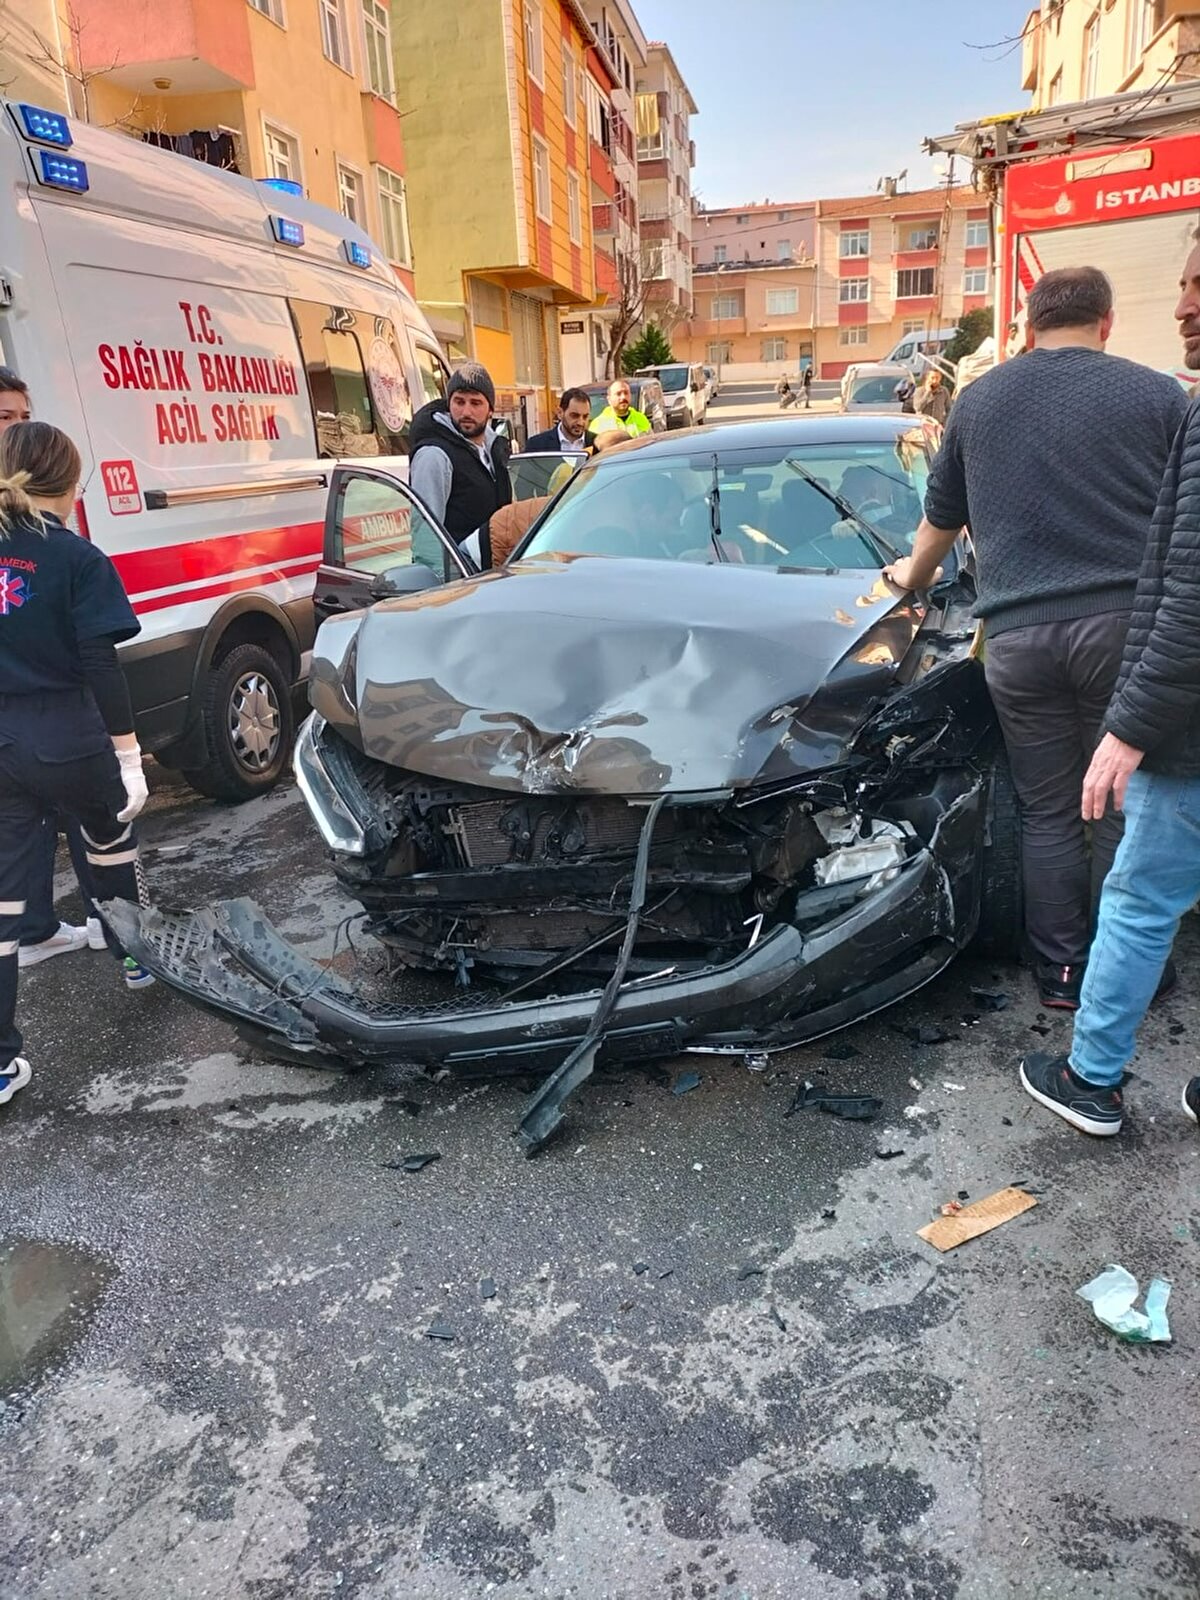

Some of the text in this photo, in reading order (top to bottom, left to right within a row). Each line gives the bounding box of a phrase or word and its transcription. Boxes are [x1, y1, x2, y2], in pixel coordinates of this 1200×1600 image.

[179, 302, 223, 345] T.C.
[98, 339, 299, 396] SAĞLIK BAKANLIĞI
[156, 396, 281, 445] ACİL SAĞLIK
[106, 466, 134, 492] 112
